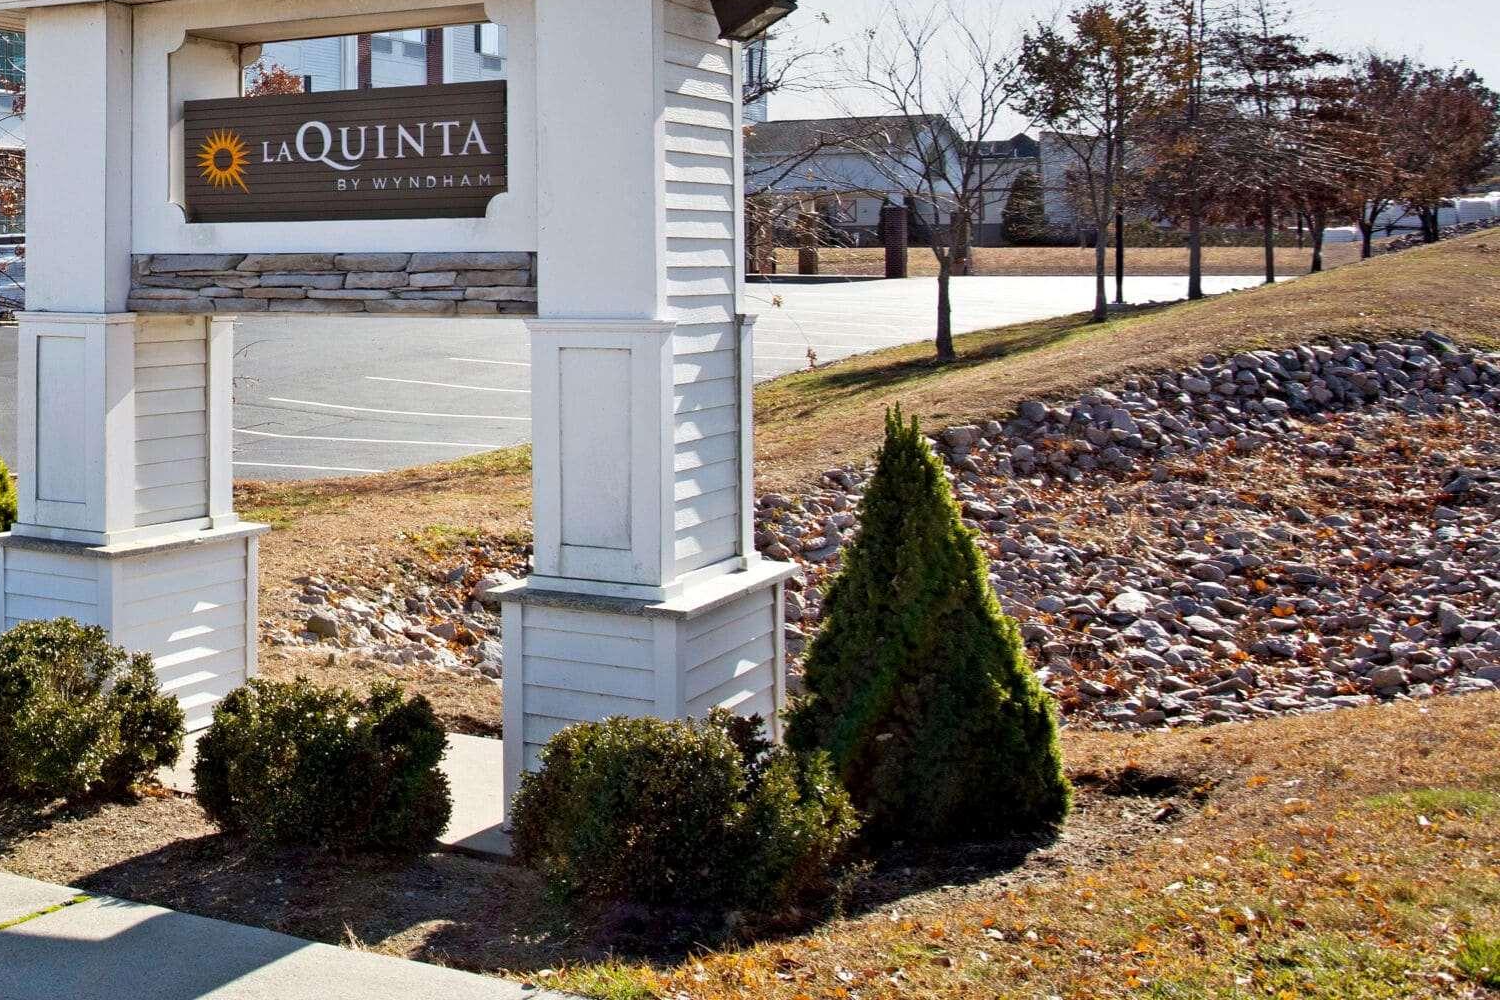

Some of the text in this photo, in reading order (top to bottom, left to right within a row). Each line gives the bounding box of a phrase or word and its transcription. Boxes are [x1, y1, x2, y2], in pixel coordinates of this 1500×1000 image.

[261, 119, 491, 171] LA QUINTA
[336, 173, 491, 191] BY WYNDHAM
